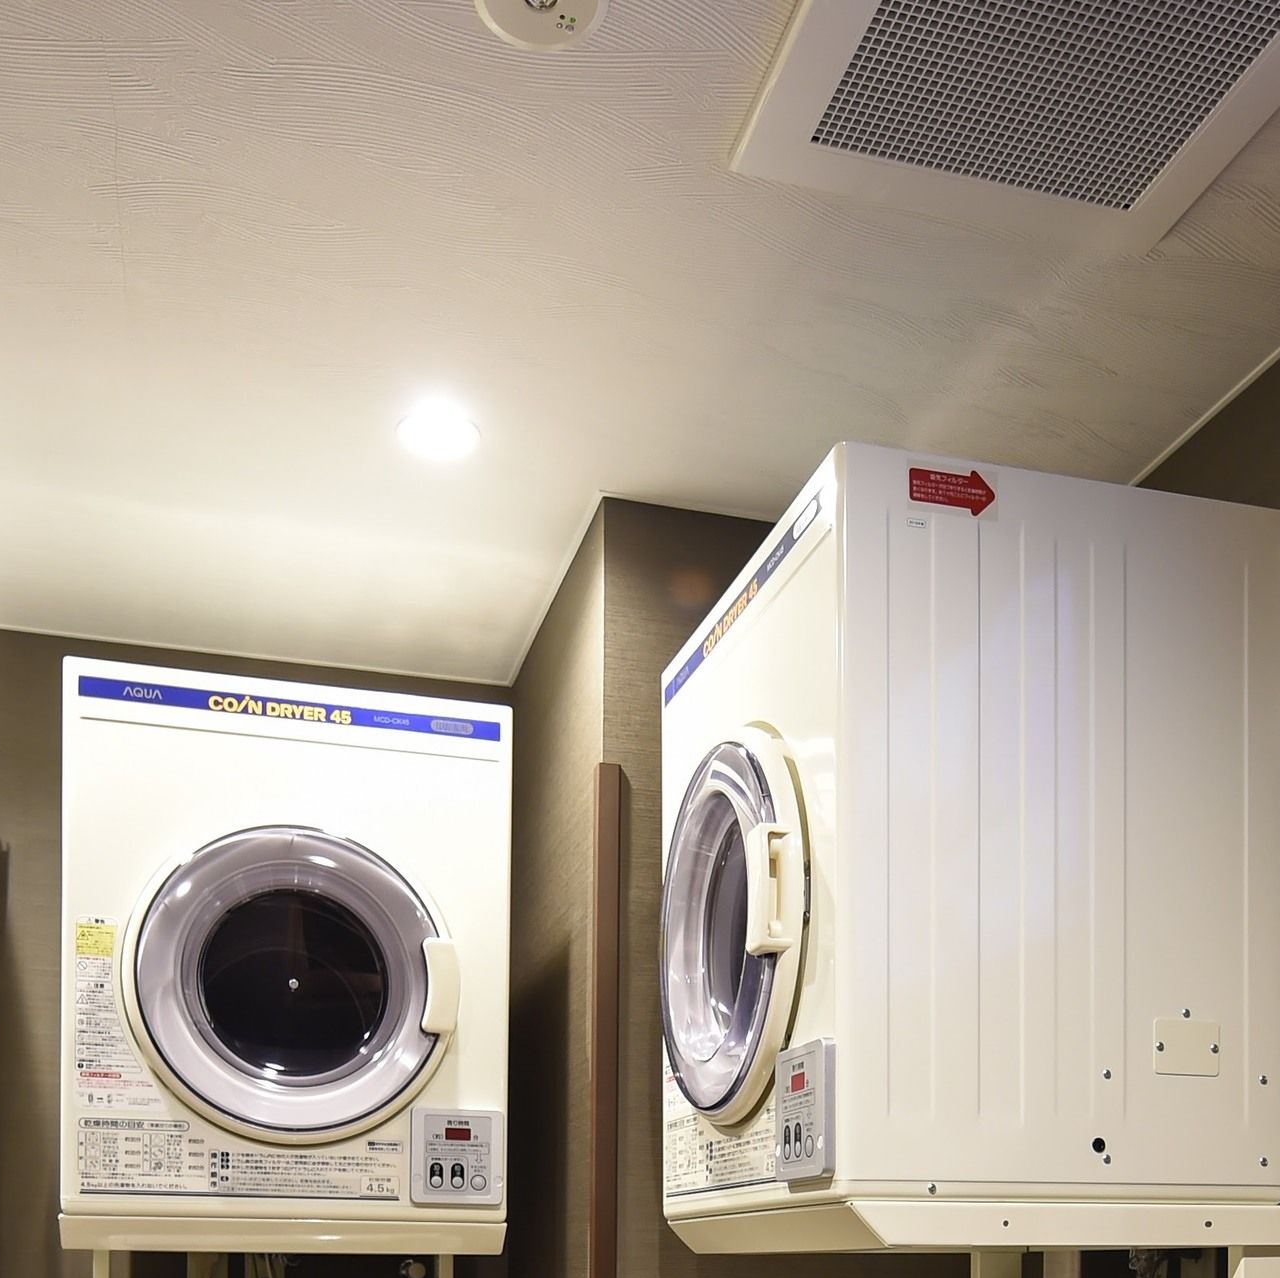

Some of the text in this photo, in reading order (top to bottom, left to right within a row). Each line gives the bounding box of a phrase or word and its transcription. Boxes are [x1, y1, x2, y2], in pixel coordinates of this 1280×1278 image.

[122, 686, 163, 701] AQUA
[266, 701, 327, 723] DRYER
[329, 709, 352, 726] 45
[366, 1183, 385, 1193] 4.5
